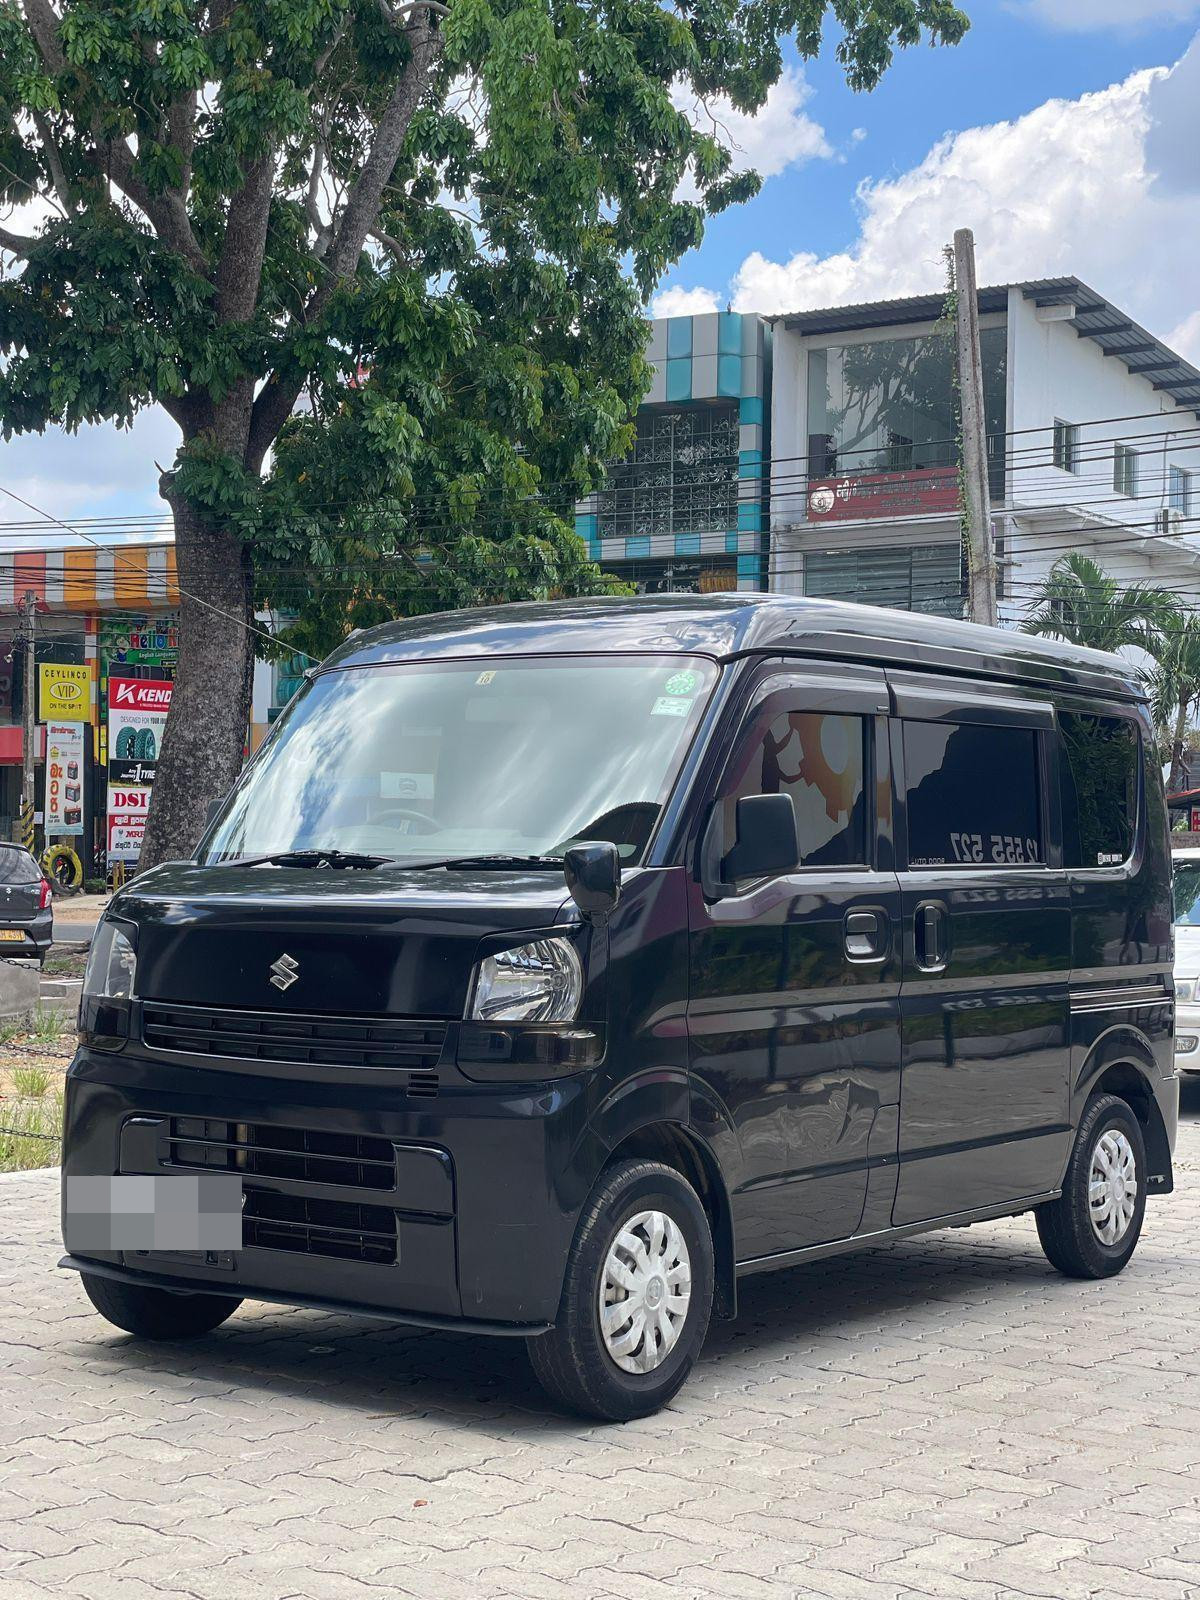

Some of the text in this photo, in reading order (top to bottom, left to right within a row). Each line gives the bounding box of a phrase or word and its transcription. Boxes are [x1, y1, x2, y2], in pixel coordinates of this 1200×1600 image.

[45, 669, 87, 680] CEYLINCO
[57, 685, 75, 698] VIP
[141, 716, 149, 724] FOR
[113, 792, 147, 807] DSI
